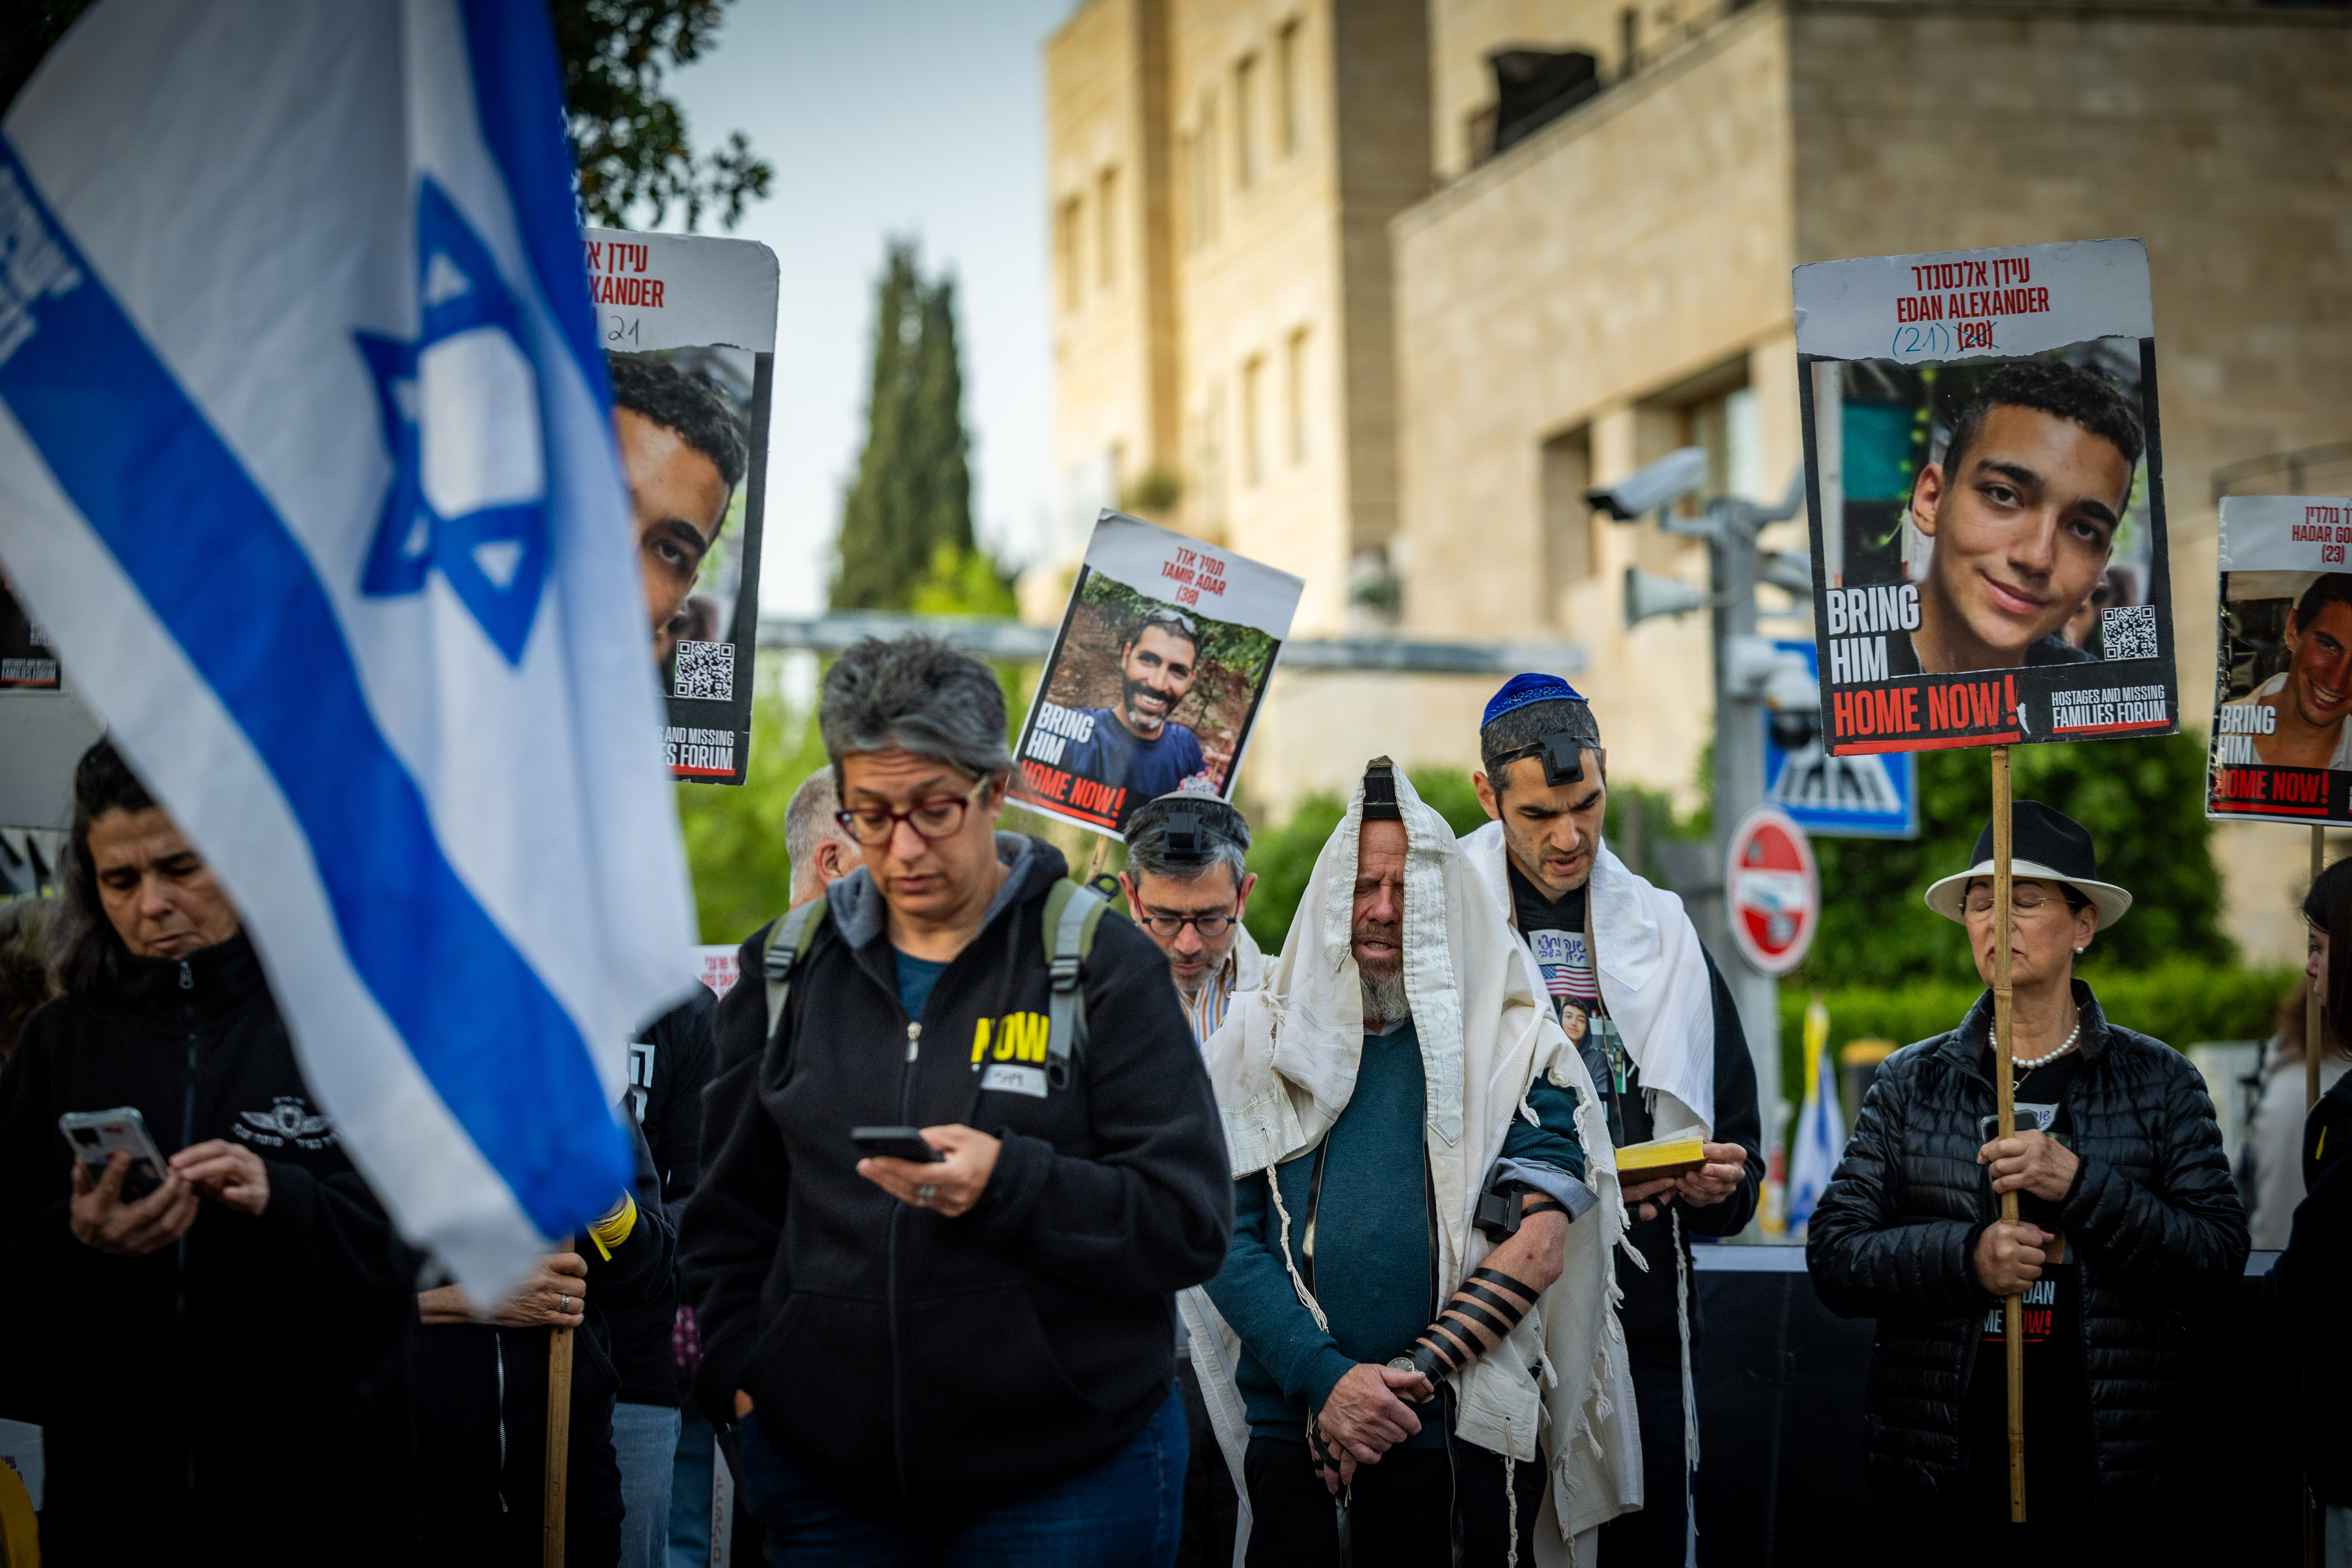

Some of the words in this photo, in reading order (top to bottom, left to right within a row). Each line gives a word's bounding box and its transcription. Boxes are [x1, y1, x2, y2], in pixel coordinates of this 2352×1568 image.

[608, 243, 648, 274] עידן
[1992, 257, 2031, 288] עידן
[1911, 260, 1987, 291] אלכסנדר
[588, 275, 665, 308] XANDER
[1896, 295, 1943, 323] EDAN
[1948, 287, 2050, 320] ALEXANDER
[608, 315, 640, 348] 21
[1892, 323, 1950, 357] (21)
[1957, 320, 1993, 351] (20)
[2305, 506, 2339, 524] גולדין
[2292, 524, 2332, 543] HADAR
[2336, 526, 2352, 544] GO
[1176, 547, 1197, 566] אדר
[1199, 554, 1225, 577] תמיר
[2321, 544, 2345, 564] (23)
[1161, 561, 1195, 585] TAMIR
[1194, 573, 1227, 597] ADAR
[1175, 584, 1200, 607] (38)
[1827, 584, 1920, 635] BRING
[1829, 636, 1889, 684] HIM
[1833, 687, 1920, 737] HOME
[1927, 674, 2019, 731] NOW!
[2052, 689, 2101, 706] HOSTAGES
[2102, 687, 2121, 704] AND
[2122, 684, 2165, 702] MISSING
[1036, 701, 1095, 744] BRING
[2053, 705, 2114, 728] FAMILIES
[2118, 701, 2167, 725] FORUM
[2220, 705, 2277, 735] BRING
[665, 726, 687, 743] AND
[688, 728, 735, 746] MISSING
[1025, 728, 1067, 765] HIM
[2217, 735, 2253, 764] HIM
[680, 744, 734, 770] FORUM
[1022, 759, 1072, 800] HOME
[1069, 777, 1127, 818] NOW!
[2215, 769, 2268, 799] HOME
[2272, 771, 2329, 804] NOW!
[2022, 1281, 2056, 1305] DAN
[2022, 1310, 2052, 1336] OW!
